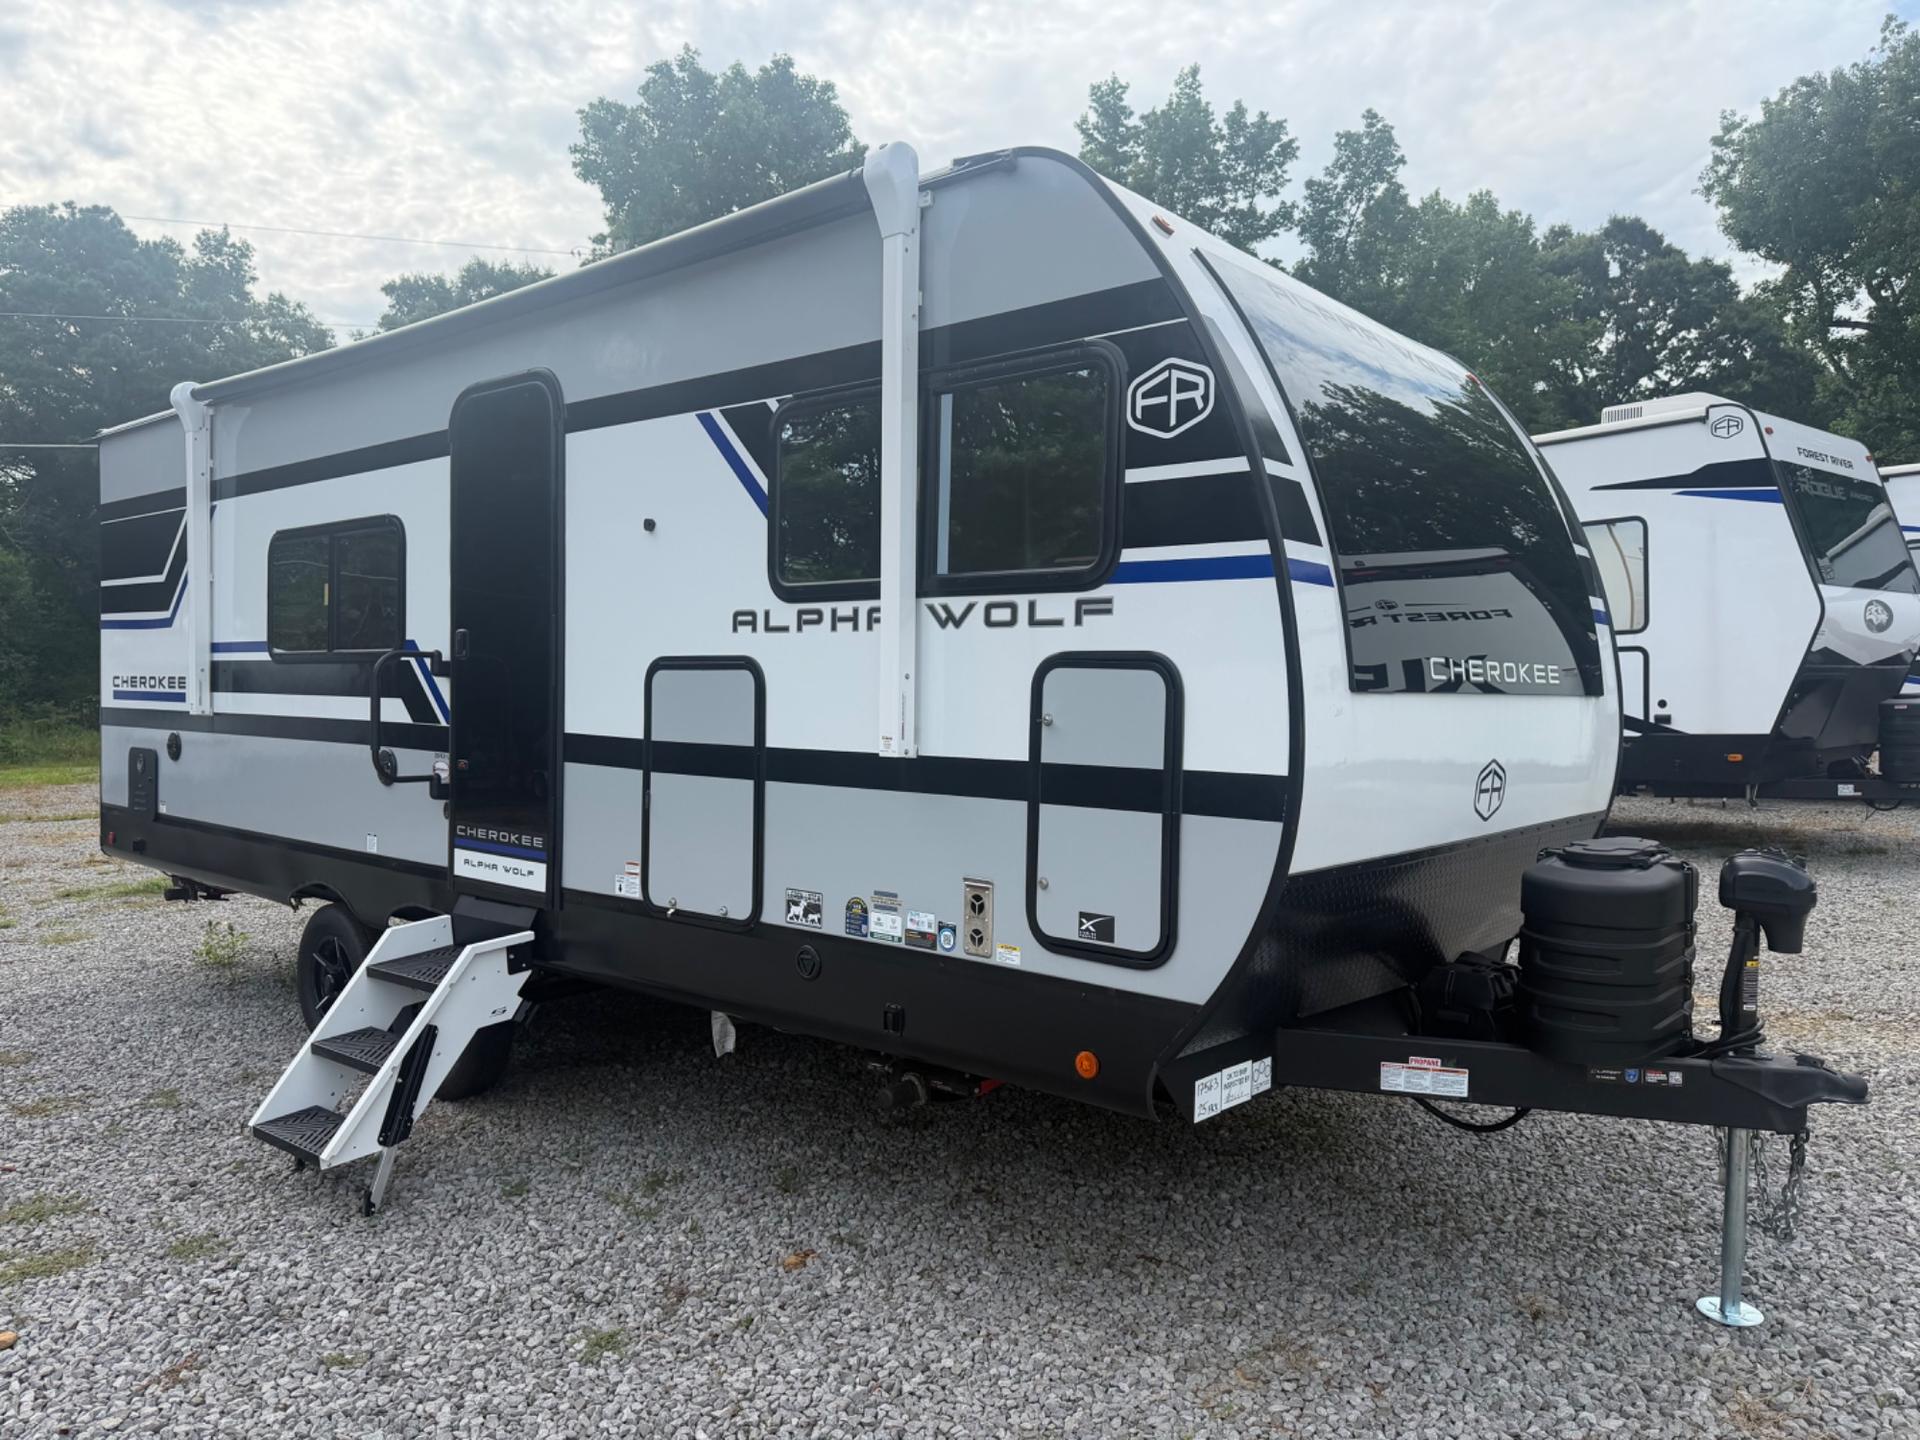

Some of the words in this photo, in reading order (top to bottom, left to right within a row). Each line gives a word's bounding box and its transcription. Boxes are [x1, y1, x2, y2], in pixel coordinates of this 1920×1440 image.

[1796, 447, 1829, 464] FOREST
[1829, 456, 1854, 470] RIVER
[924, 596, 1114, 630] WOLF
[1429, 657, 1560, 684] CHEROKEE
[112, 675, 187, 690] CHEROKEE
[456, 824, 544, 848] CHEROKEE
[463, 858, 498, 871] ALPHA
[502, 865, 535, 877] WOLF
[1410, 1058, 1440, 1067] PROPANE
